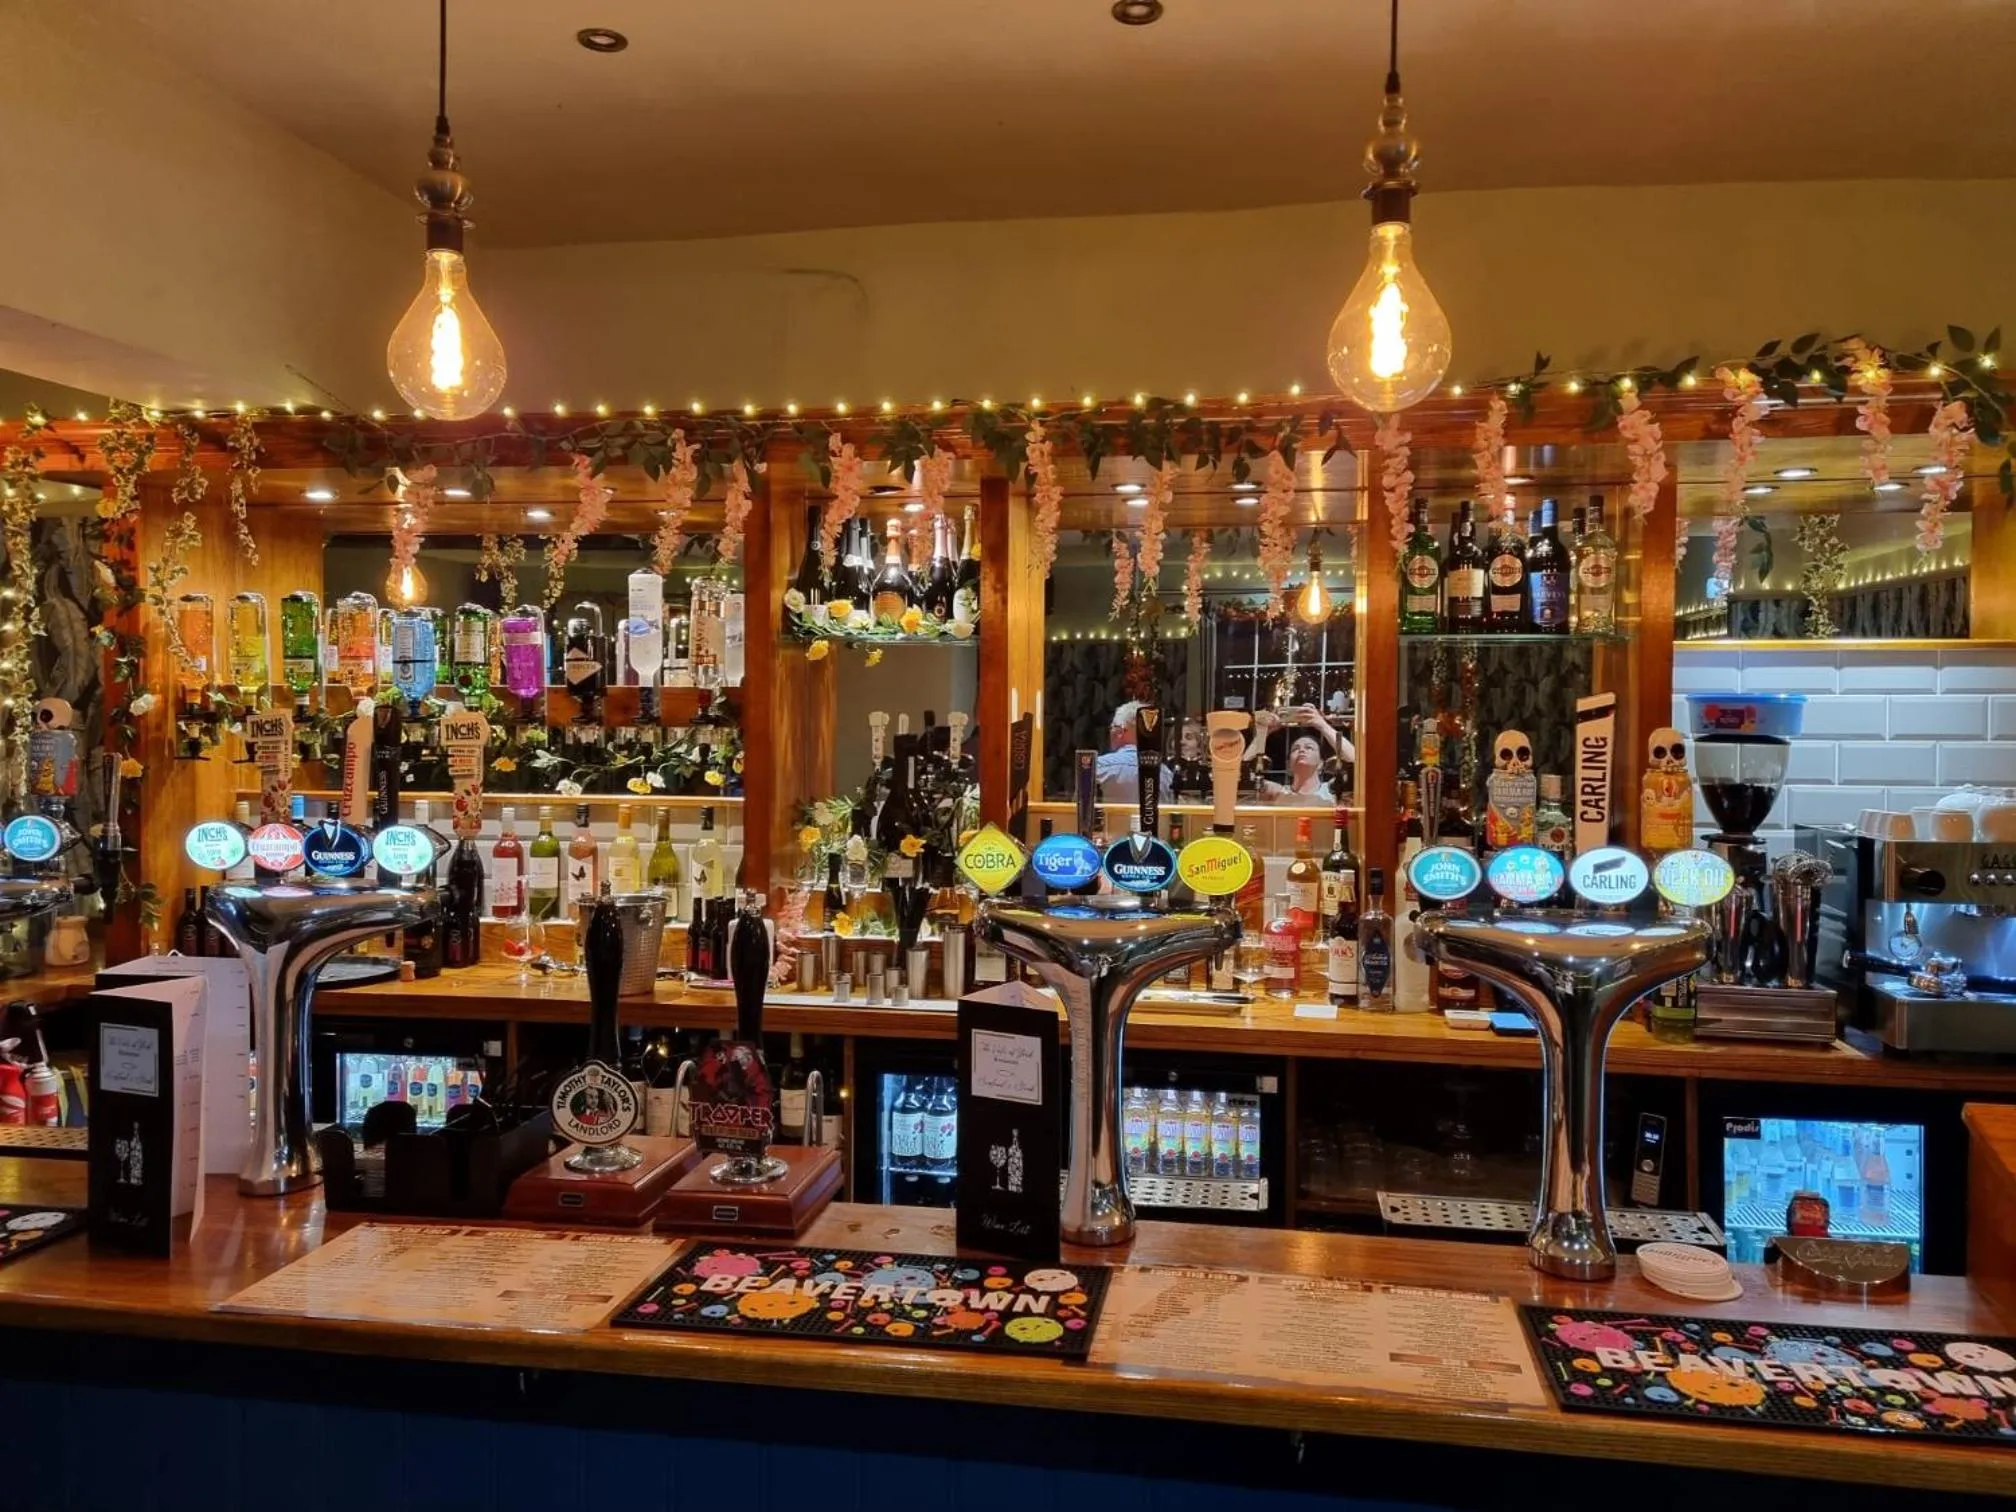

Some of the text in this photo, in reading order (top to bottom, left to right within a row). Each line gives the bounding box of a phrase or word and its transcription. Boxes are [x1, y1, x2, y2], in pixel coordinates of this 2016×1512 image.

[251, 718, 284, 738] INCH'S
[445, 722, 481, 742] INCH'S
[1579, 736, 1608, 824] CARLING
[1143, 777, 1154, 825] GUINNESS
[197, 827, 228, 843] INCH'S
[385, 830, 416, 847] INCH'S
[311, 850, 356, 861] GUINNESS
[964, 853, 1017, 869] COBRA
[1037, 853, 1073, 871] Tiger
[1113, 863, 1166, 876] GUINNESS
[1582, 874, 1637, 890] CARLING
[557, 1074, 632, 1113] TIMOTHY TAYLOR'S
[567, 1118, 622, 1137] LANDLORD
[699, 1273, 1052, 1315] BEAVERTOWN
[1595, 1345, 2016, 1399] BEAVERTOWN
